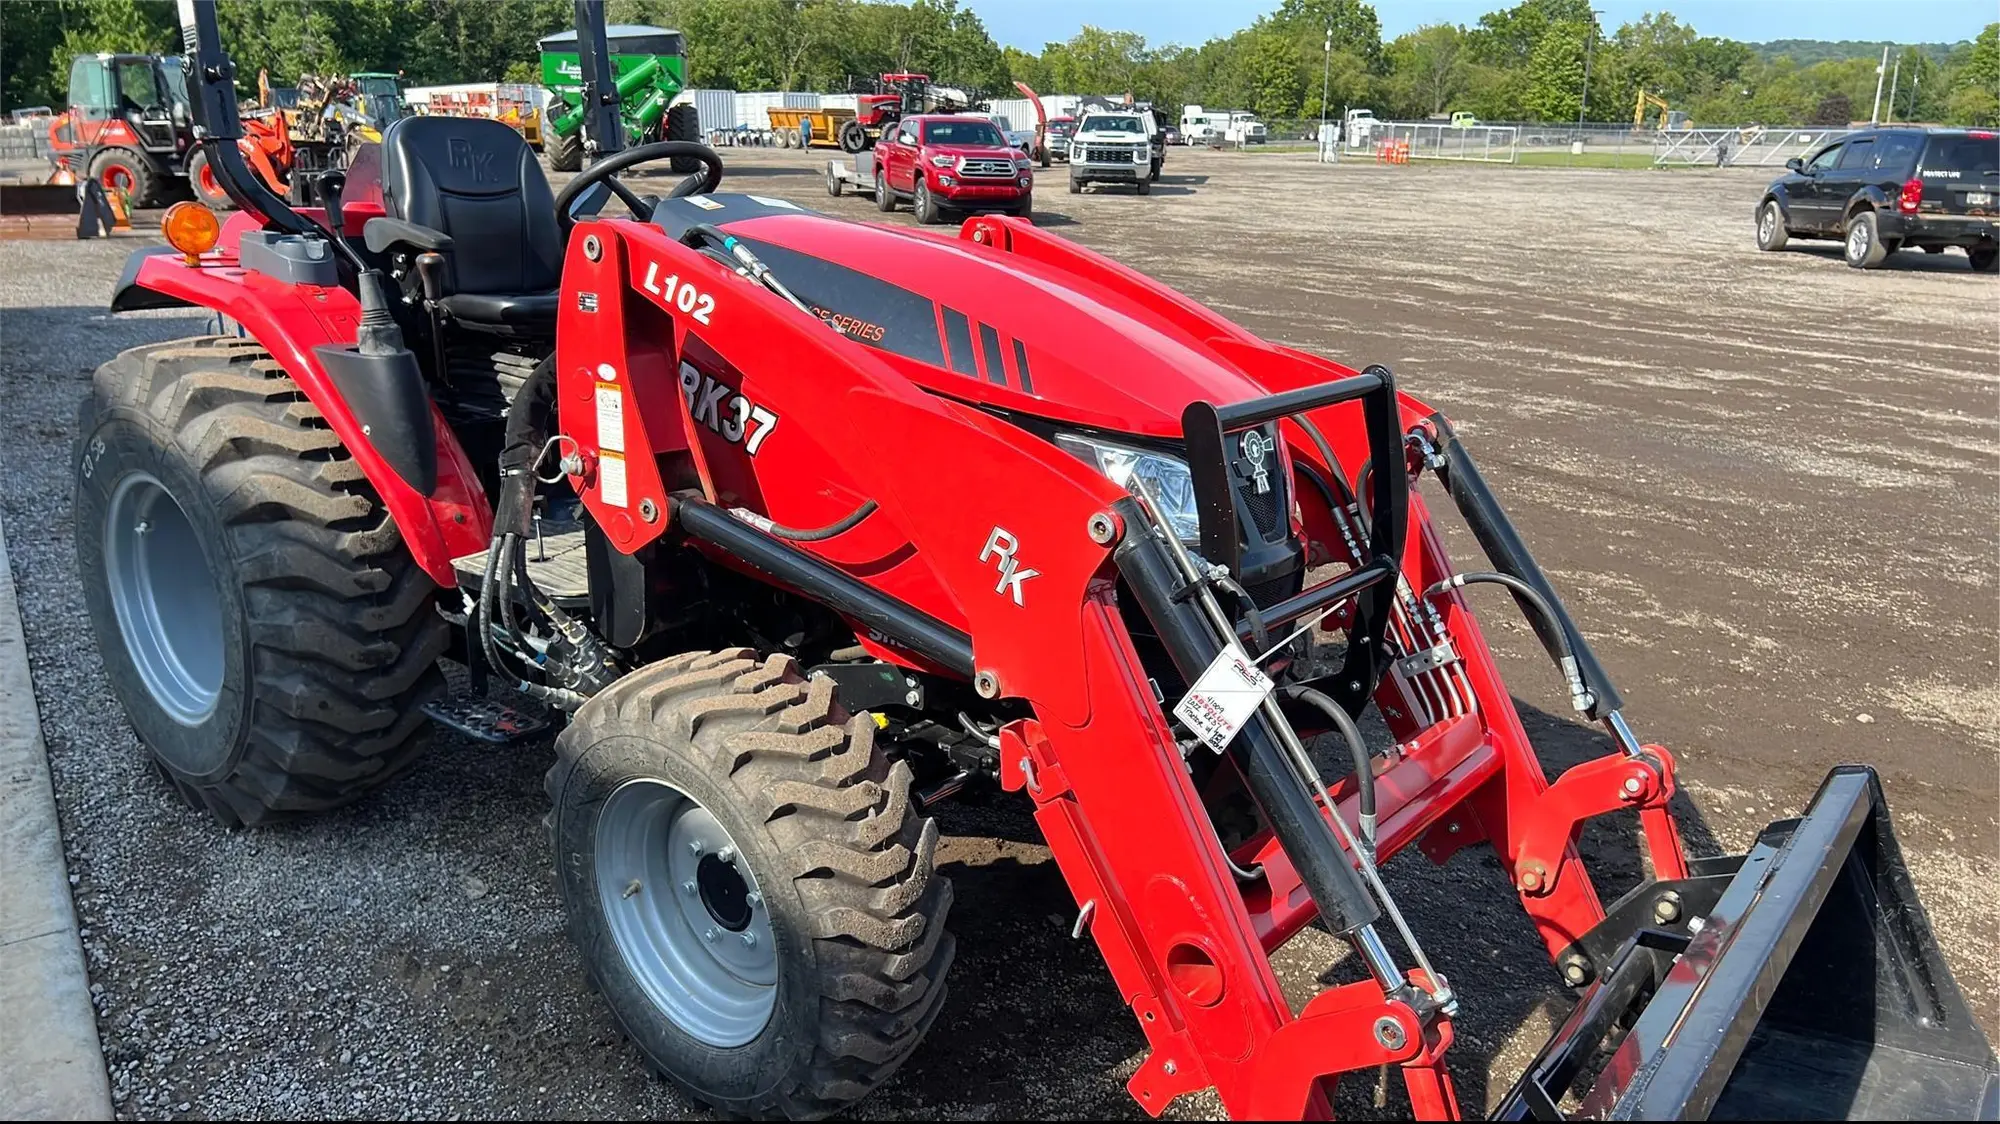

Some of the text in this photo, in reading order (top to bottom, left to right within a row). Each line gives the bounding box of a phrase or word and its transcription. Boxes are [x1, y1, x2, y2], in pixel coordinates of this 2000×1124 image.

[643, 261, 716, 326] L102
[832, 313, 886, 341] SERIES
[678, 357, 779, 458] RK37
[978, 524, 1042, 608] RK
[1191, 693, 1235, 732] ABSOLUTE
